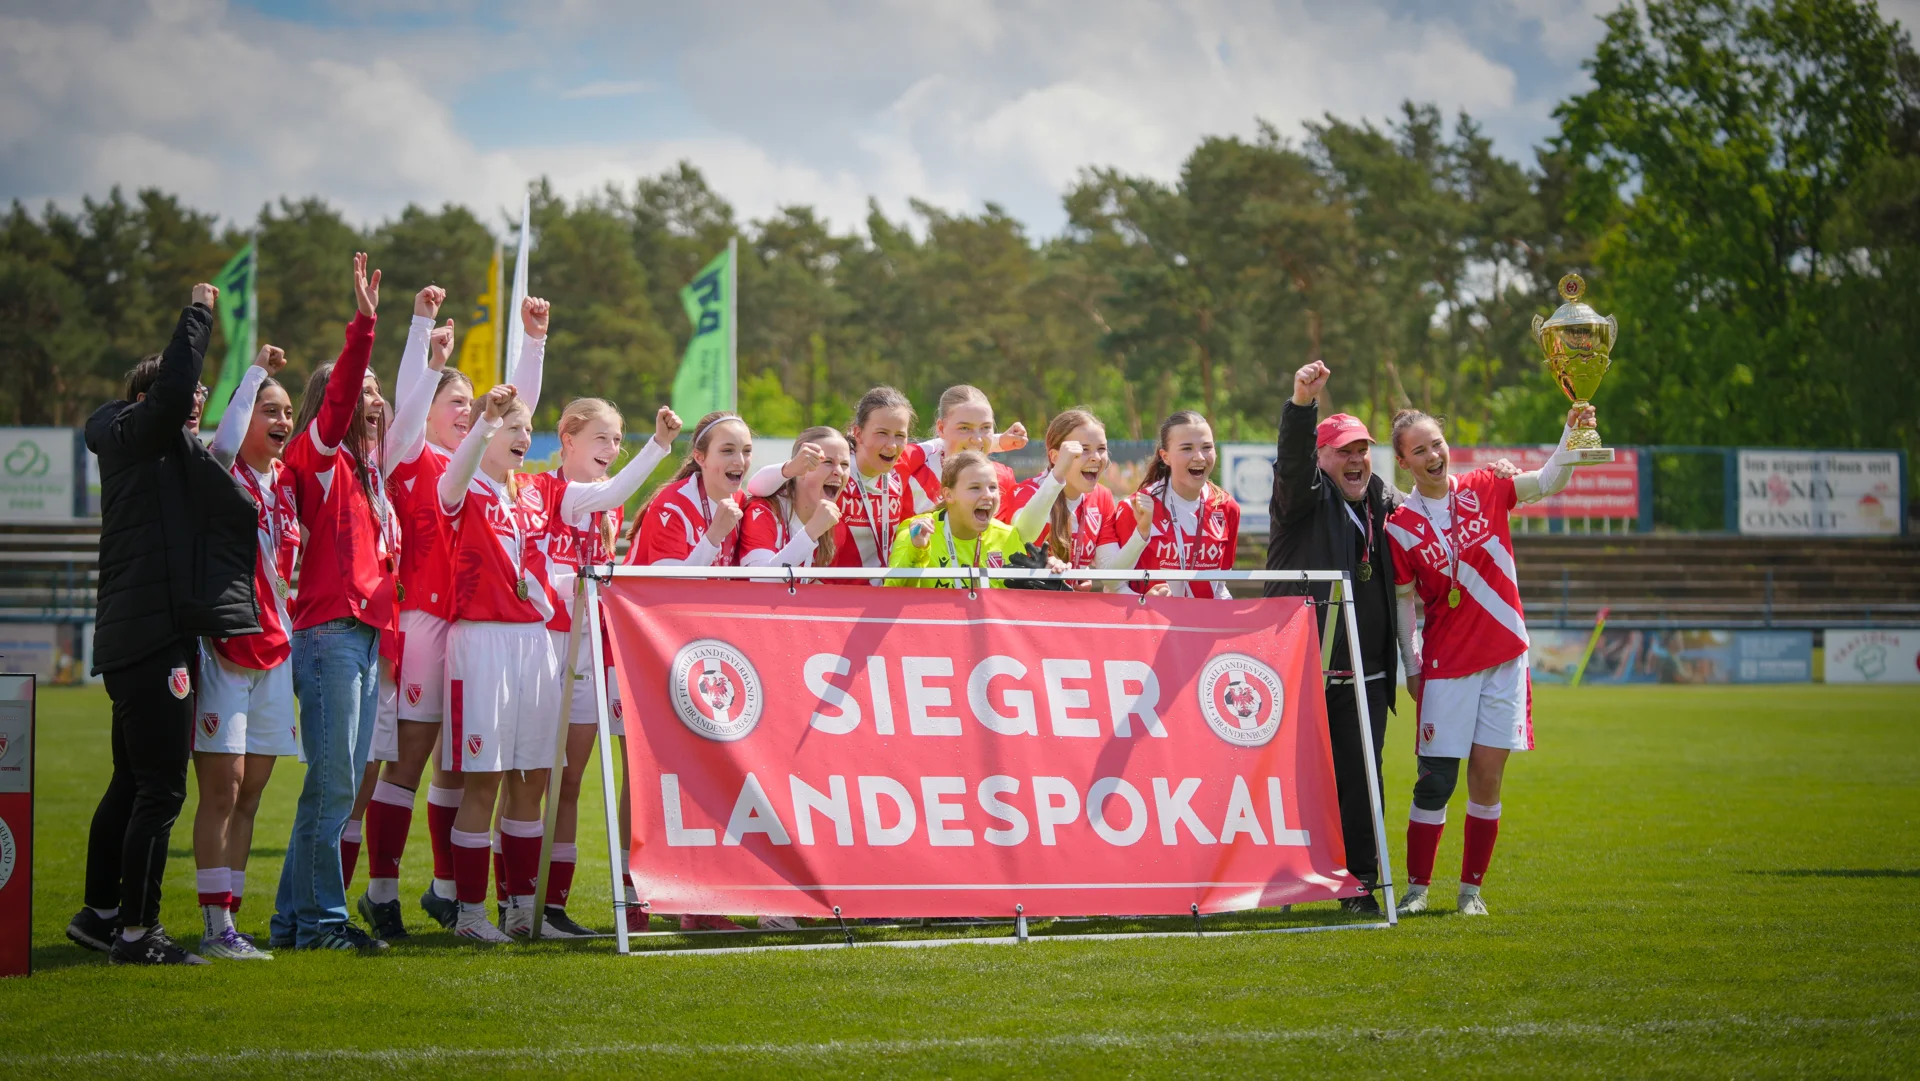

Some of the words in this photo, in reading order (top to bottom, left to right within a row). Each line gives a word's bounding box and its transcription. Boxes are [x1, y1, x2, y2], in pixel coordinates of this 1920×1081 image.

[1745, 476, 1837, 500] MNEY
[1156, 540, 1225, 561] MYTHOS
[1420, 511, 1489, 565] MYTHOS
[679, 647, 755, 702] FUSSBALL-LANDESVERBAND
[803, 652, 1168, 738] SIEGER
[684, 705, 745, 734] BRANDENBURG
[1213, 716, 1272, 740] BRANDENBURG
[660, 772, 1311, 847] LANDESPOKAL
